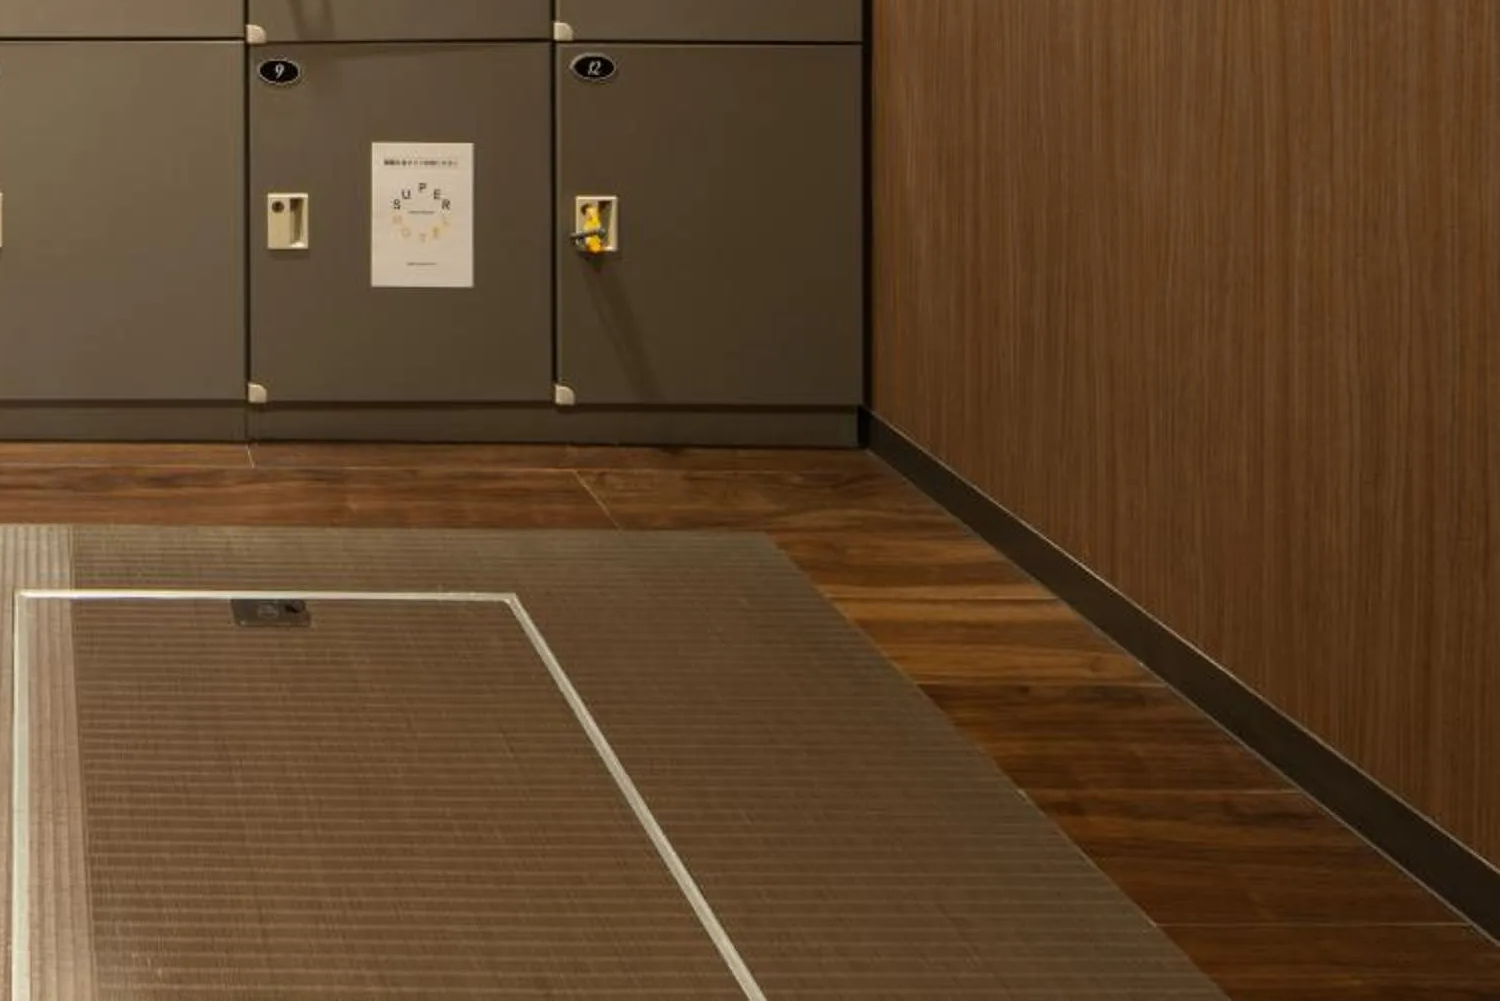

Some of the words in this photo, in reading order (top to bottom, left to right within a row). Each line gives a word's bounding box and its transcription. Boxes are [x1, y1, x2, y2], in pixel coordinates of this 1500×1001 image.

[275, 63, 284, 78] 9
[588, 61, 601, 76] 12
[393, 182, 450, 210] SUPER
